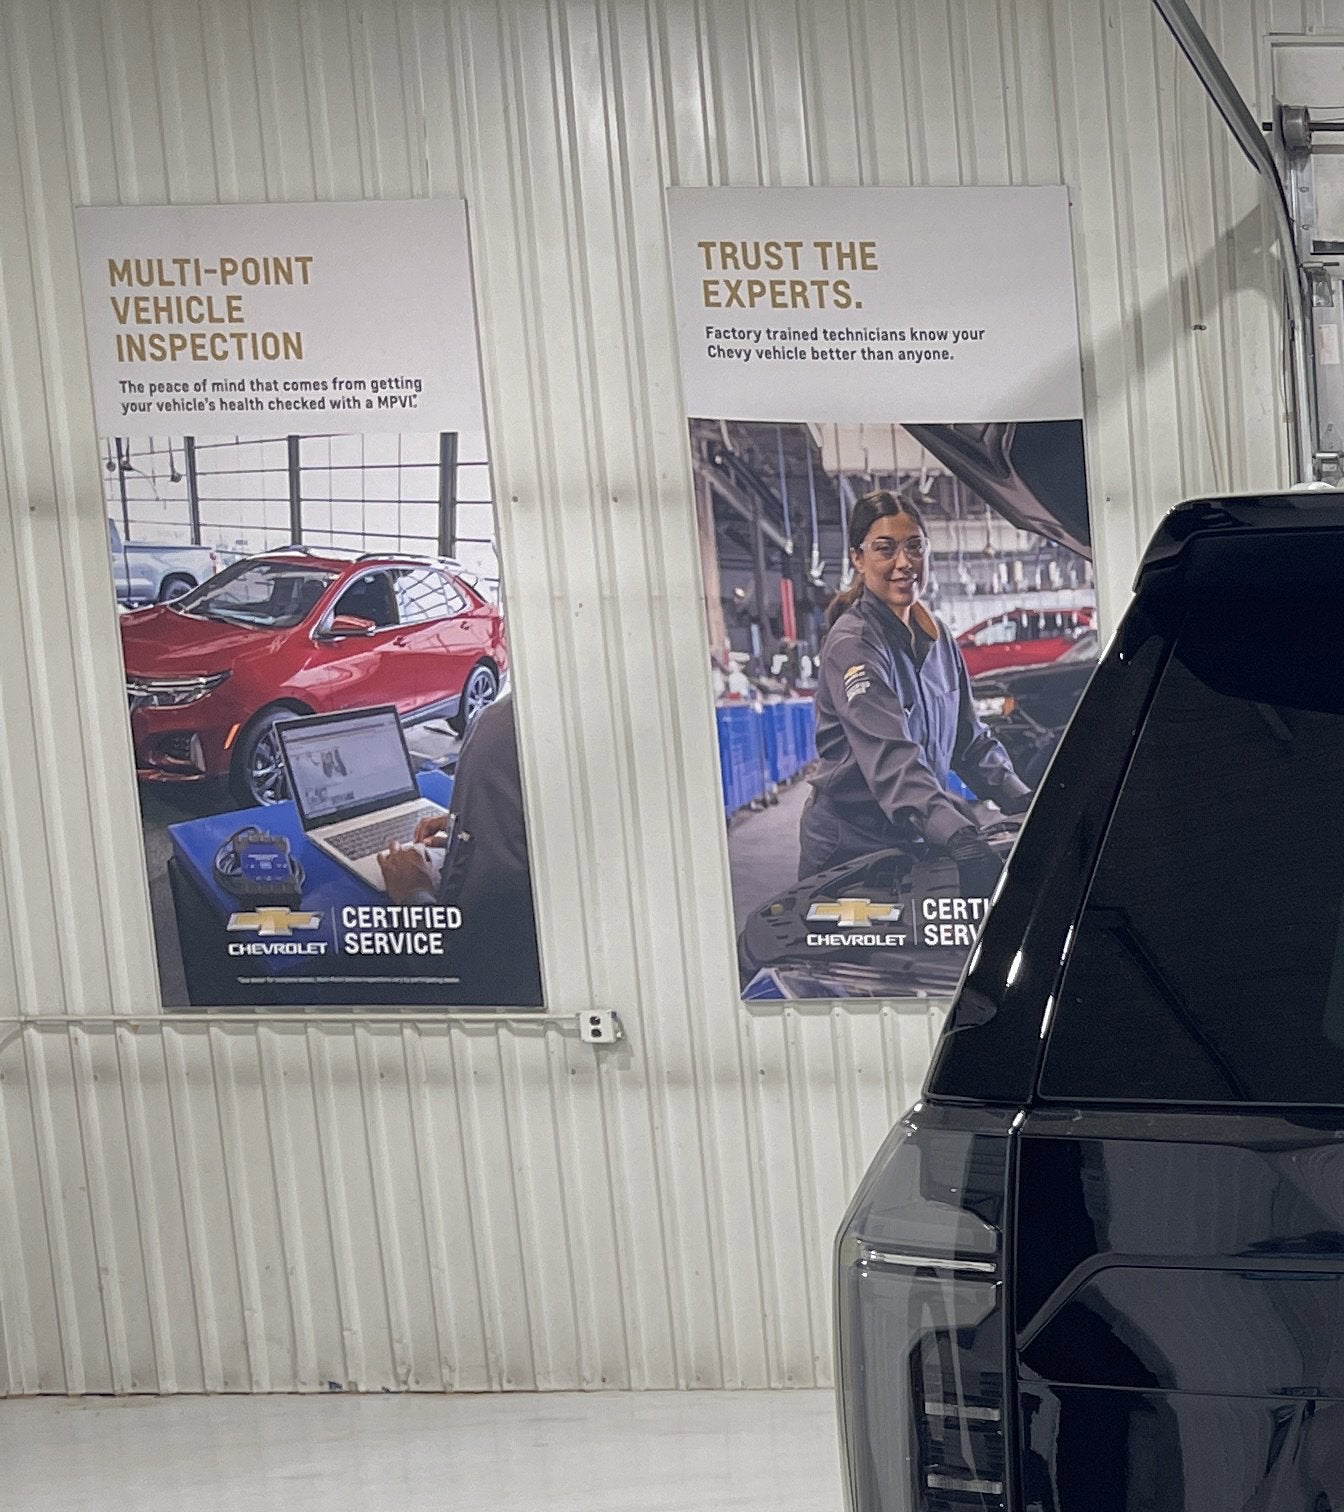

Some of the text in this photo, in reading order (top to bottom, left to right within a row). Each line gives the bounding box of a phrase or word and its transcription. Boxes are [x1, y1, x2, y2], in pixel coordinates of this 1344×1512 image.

[698, 241, 878, 271] TRUST THE
[108, 256, 313, 287] MULTI-POINT
[703, 279, 863, 309] EXPERTS.
[110, 295, 245, 325] VEHICLE
[705, 326, 986, 344] Factory trained technicians know your
[116, 332, 303, 362] INSPECTION
[707, 345, 954, 364] Chevy vehicle better than anyone.
[119, 377, 423, 397] The peace of mind that comes from getting
[121, 401, 151, 416] your
[157, 398, 216, 412] vehicle's
[219, 397, 264, 412] health
[268, 396, 326, 411] checked
[329, 395, 361, 410] with
[365, 398, 373, 409] a
[341, 906, 462, 929] CERTIFIED
[227, 942, 328, 956] CHEVROLET
[343, 932, 444, 955] SERVICE
[806, 934, 907, 946] CHEVROLET
